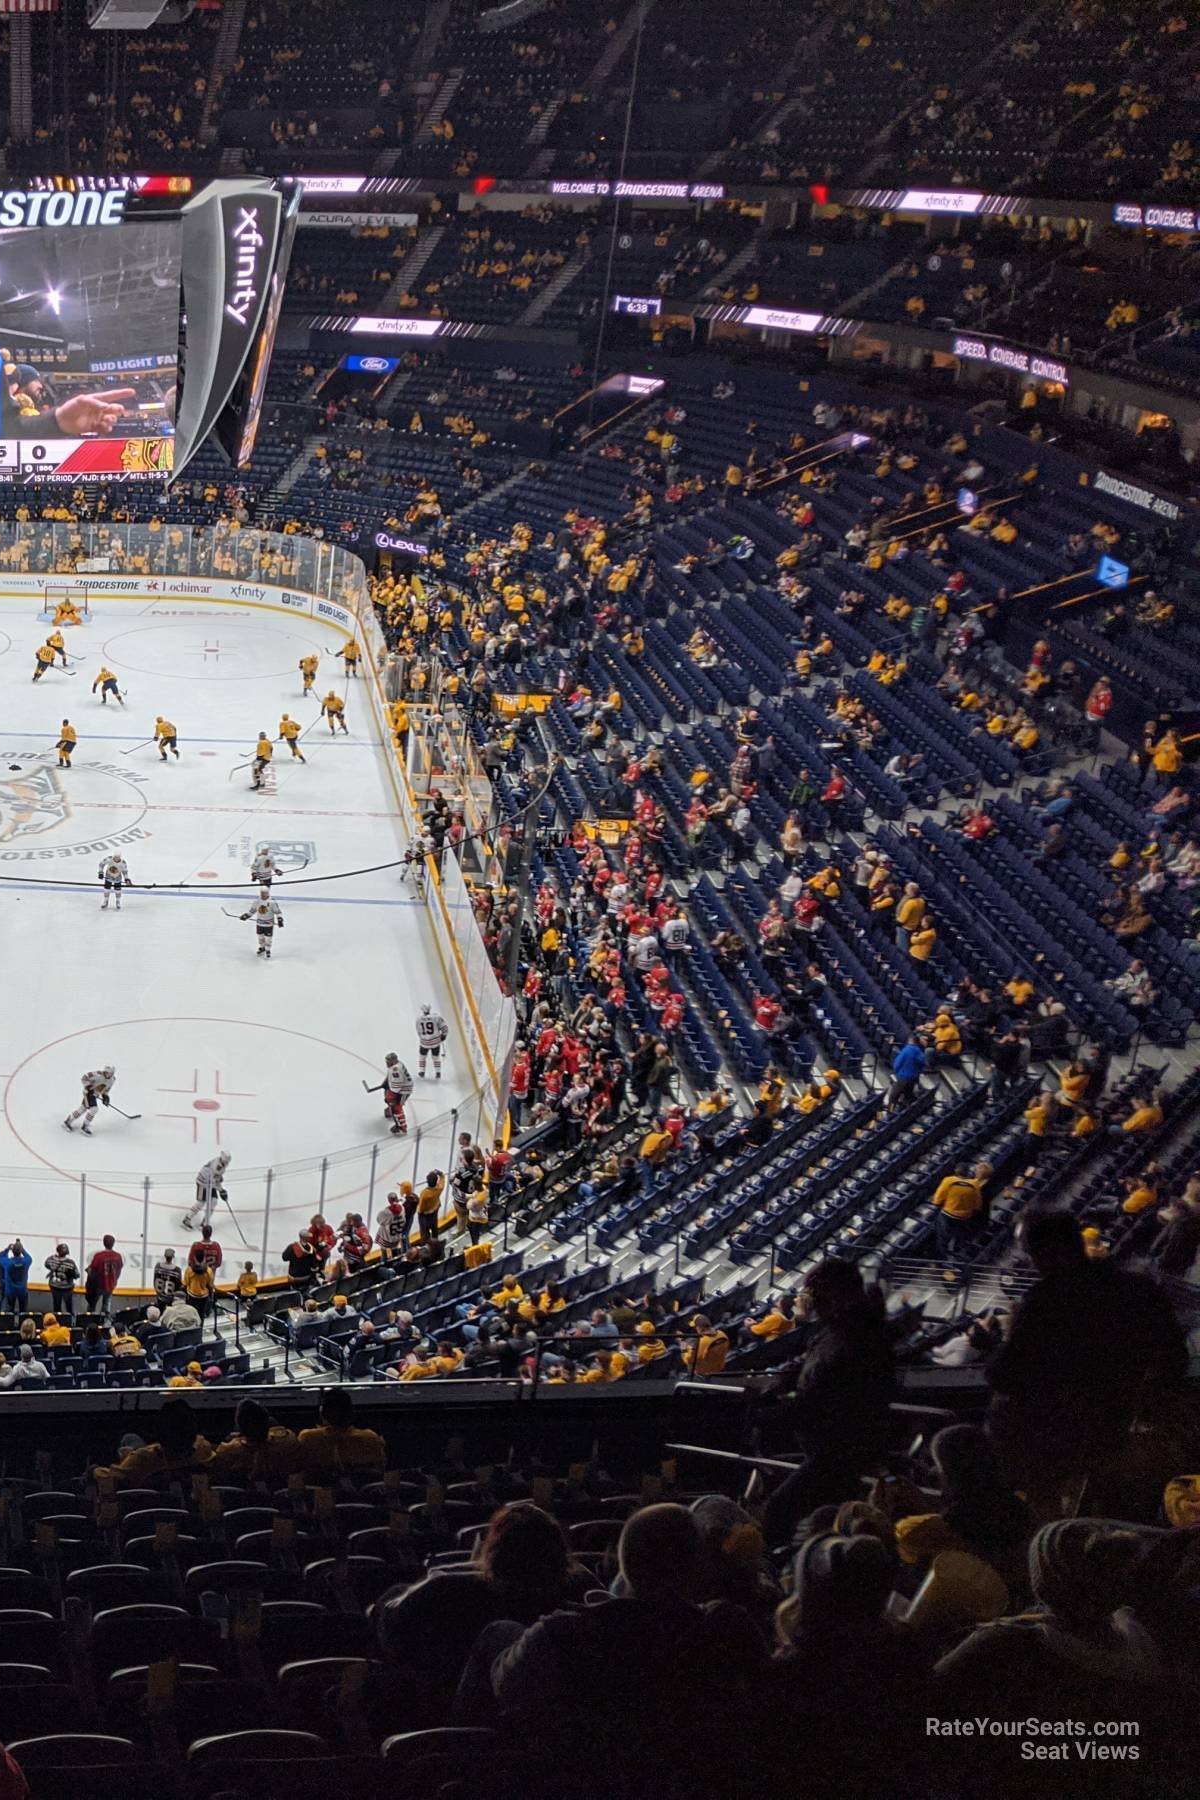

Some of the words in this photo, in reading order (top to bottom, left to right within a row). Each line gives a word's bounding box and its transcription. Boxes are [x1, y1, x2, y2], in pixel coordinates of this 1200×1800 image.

[552, 182, 595, 195] WELCOME
[596, 183, 610, 195] TO
[614, 182, 689, 198] BRIDGESTONE
[689, 185, 724, 198] ARENA
[308, 215, 353, 224] ACURA
[358, 215, 400, 225] LEVEL
[1144, 208, 1195, 230] COVERAGE.
[226, 207, 263, 325] xfinity
[626, 302, 649, 313] 6:38
[90, 362, 116, 373] BUD
[116, 357, 153, 370] LIGHT
[953, 339, 988, 359] SPEED.
[989, 346, 1030, 372] COVERAGE.
[1030, 358, 1069, 383] CONTROL.
[31, 444, 46, 460] 0
[47, 474, 73, 483] PERIOD
[82, 474, 99, 482] NJD:
[100, 473, 121, 481] 6-8-4
[129, 472, 147, 480] MTL:
[1093, 470, 1155, 510] BRIDGESTONE
[1151, 497, 1179, 521] ARENA
[390, 537, 429, 555] LEXUS
[75, 579, 140, 591] BRIDGESTONE
[162, 580, 213, 594] Lochinvar
[230, 584, 266, 601] xfinity
[318, 603, 333, 616] BUD
[332, 607, 350, 624] LIGHT
[82, 760, 150, 784] ARENA
[420, 1021, 435, 1036] 19
[155, 1280, 176, 1295] 88
